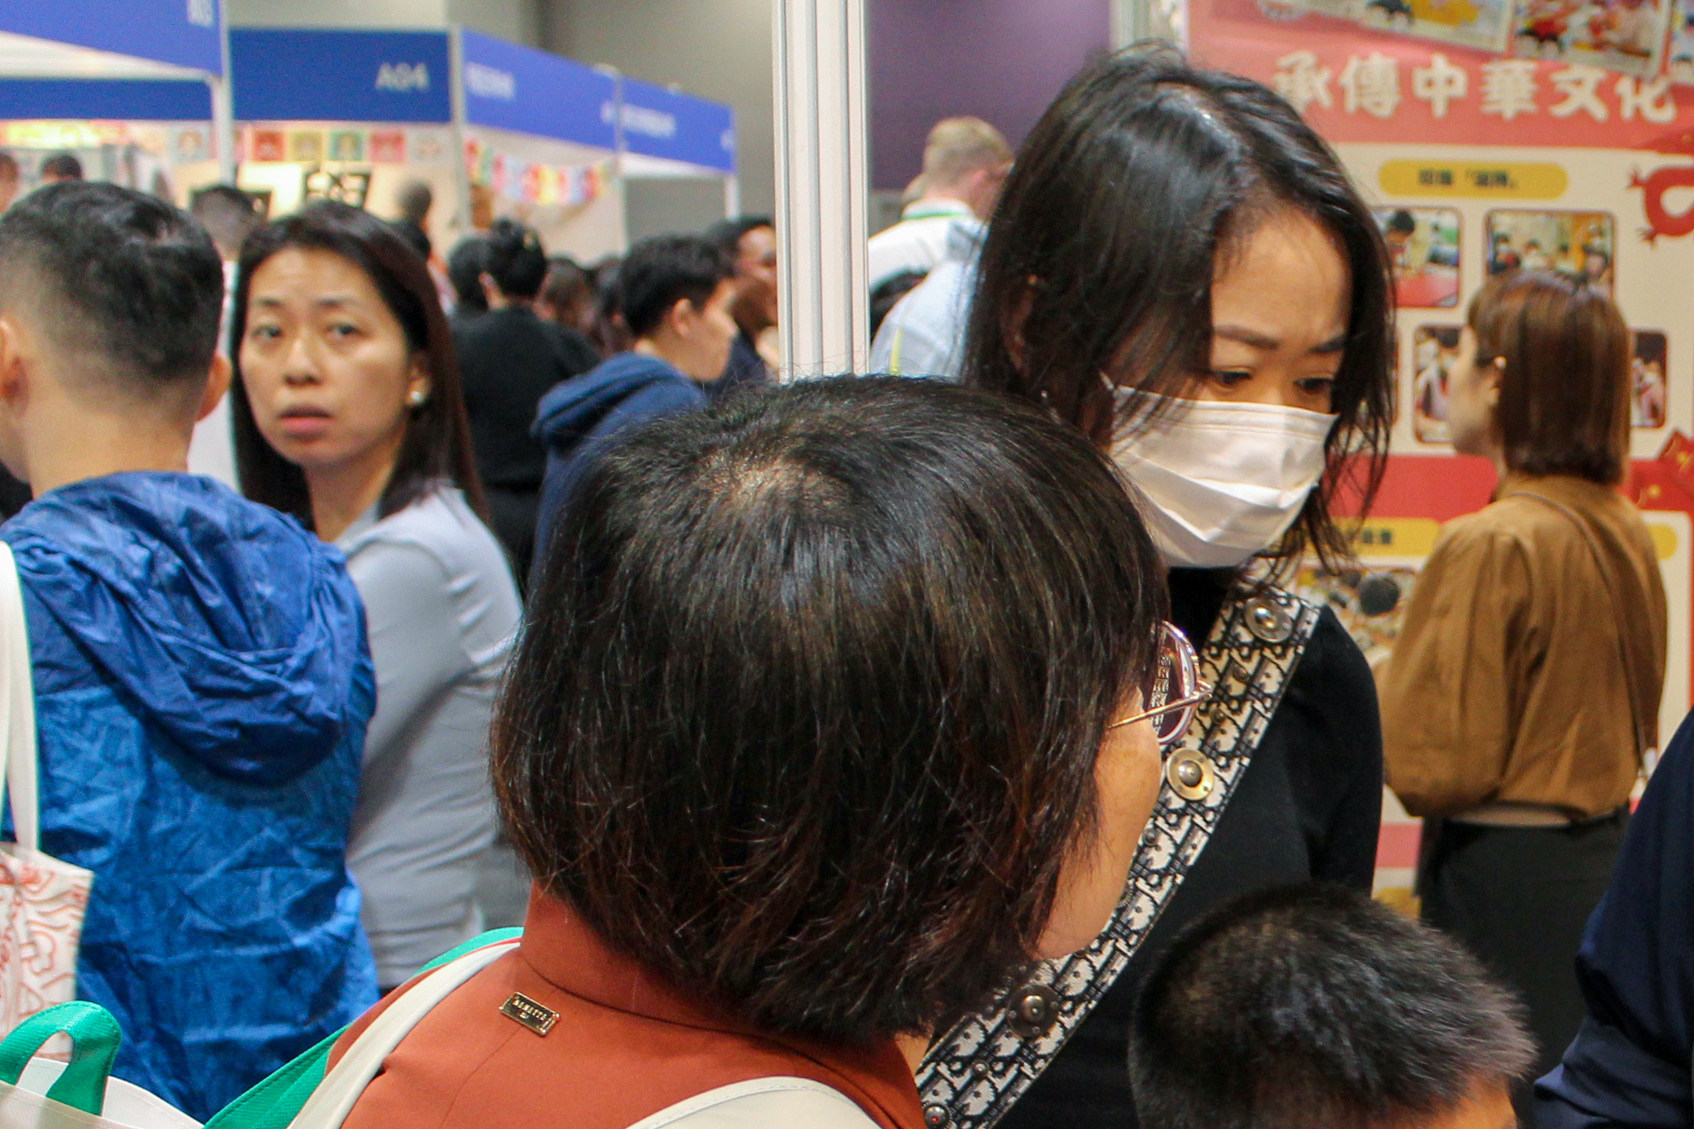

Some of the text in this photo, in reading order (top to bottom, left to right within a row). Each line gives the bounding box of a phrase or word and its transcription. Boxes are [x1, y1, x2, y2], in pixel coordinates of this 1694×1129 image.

[375, 62, 430, 91] A04
[1272, 50, 1676, 124] 承傳中華文化
